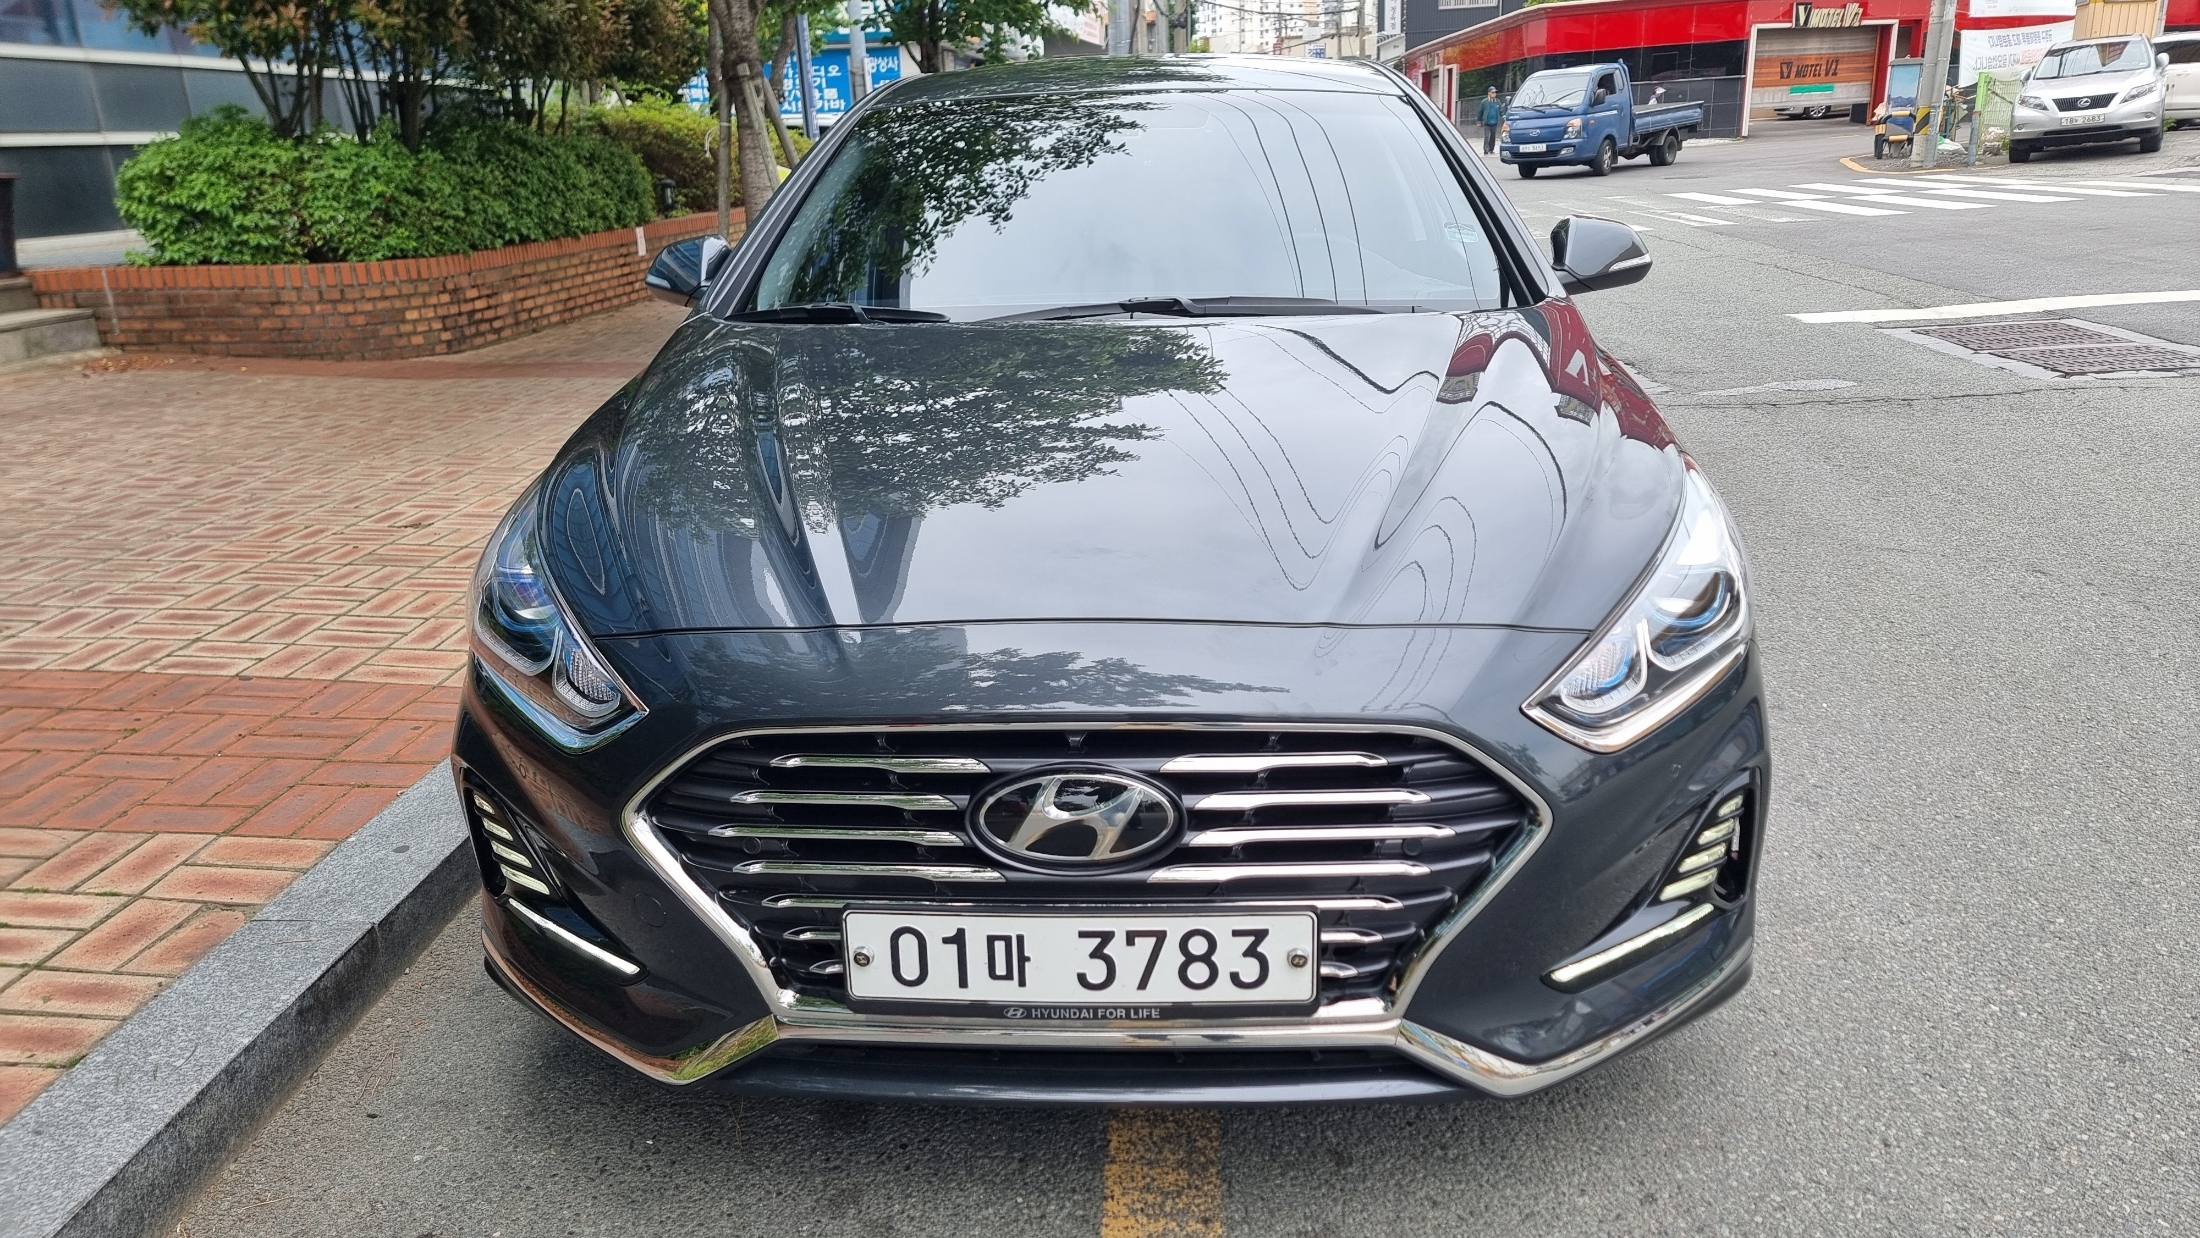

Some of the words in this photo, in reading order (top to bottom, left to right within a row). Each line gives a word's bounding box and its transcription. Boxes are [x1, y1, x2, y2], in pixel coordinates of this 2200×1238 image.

[1809, 8, 1845, 28] MOTEL
[1795, 63, 1823, 78] MOTEL
[889, 925, 1031, 989] 01마
[1076, 927, 1271, 991] 3783
[1032, 1008, 1093, 1019] HYUNDAI
[1098, 1008, 1126, 1018] FOR
[1130, 1008, 1160, 1018] LIFE
